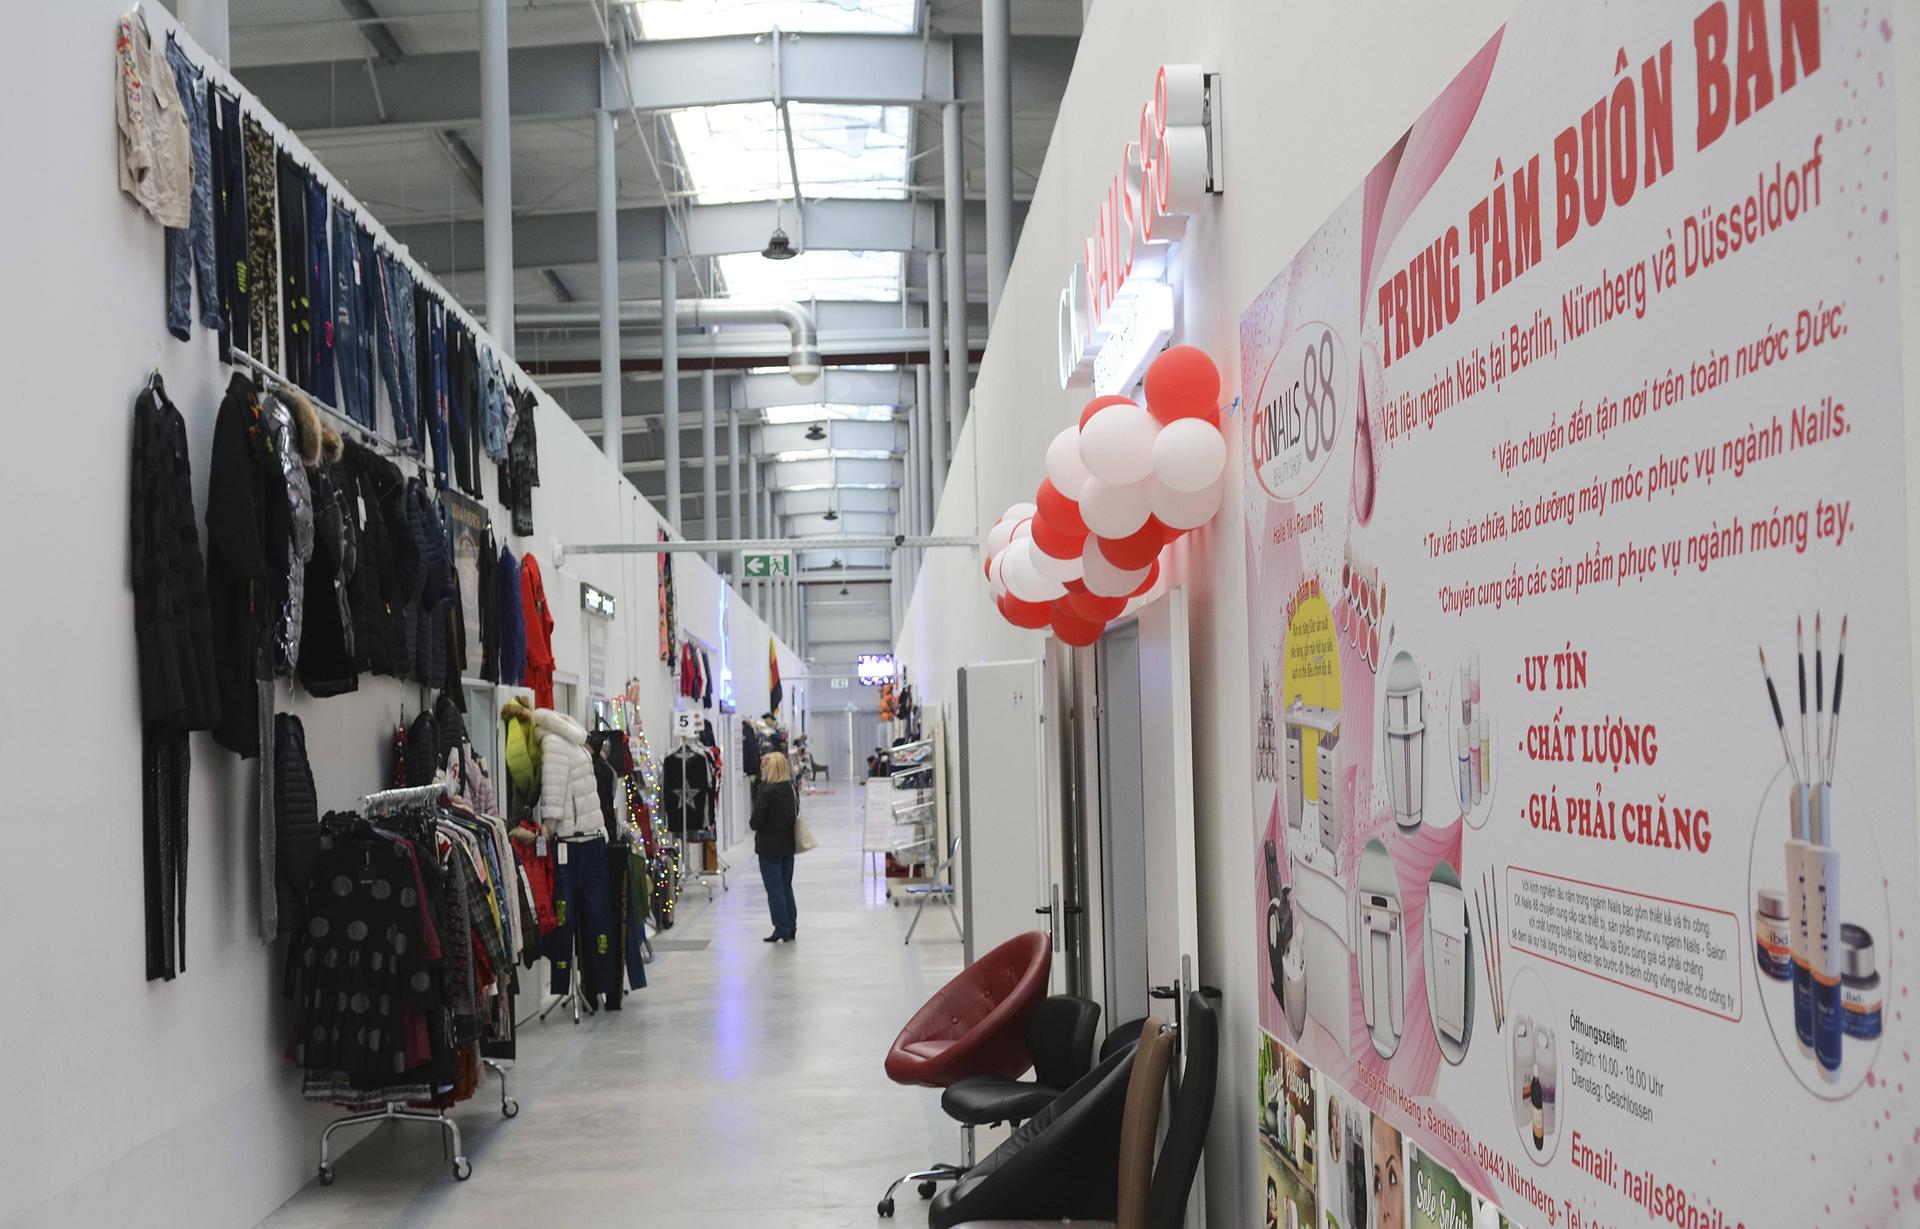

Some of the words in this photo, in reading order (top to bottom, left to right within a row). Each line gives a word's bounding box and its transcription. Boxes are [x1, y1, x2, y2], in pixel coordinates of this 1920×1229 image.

[1379, 226, 1461, 369] TRUNG
[1469, 153, 1542, 305] TÂM
[1554, 40, 1674, 249] BUÔN
[1400, 391, 1418, 440] liệu
[1420, 367, 1454, 430] ngành
[1456, 349, 1487, 402] Nails
[1490, 332, 1506, 392] tại
[1510, 309, 1558, 373] Berlin,
[1562, 260, 1646, 344] Nürnberg
[1652, 228, 1677, 293] và
[1683, 134, 1823, 278] Düsseldorf
[1304, 329, 1336, 462] 88
[1522, 413, 1564, 463] chuyển
[1568, 401, 1592, 444] đến
[1597, 397, 1618, 440] tận
[1622, 379, 1648, 423] nơi
[1652, 368, 1684, 411] trên
[1690, 350, 1730, 396] toàn
[1736, 324, 1789, 378] nước
[1796, 300, 1847, 353] Đức.
[1511, 500, 1531, 533] bảo
[1535, 491, 1574, 526] dưỡng
[1579, 475, 1607, 516] máy
[1611, 464, 1643, 503] móc
[1648, 454, 1689, 502] phục
[1695, 446, 1716, 485] vụ
[1722, 415, 1783, 477] ngành
[1790, 396, 1850, 450] Nails.
[1297, 513, 1312, 535] Raum
[1478, 580, 1501, 609] cung
[1505, 562, 1523, 605] cấp
[1527, 563, 1547, 595] các
[1550, 557, 1572, 590] sản
[1576, 541, 1613, 594] phẩm
[1618, 542, 1657, 587] phục
[1662, 539, 1681, 576] vụ
[1687, 516, 1744, 572] ngành
[1750, 506, 1808, 553] móng
[1816, 499, 1854, 546] tay.
[1525, 655, 1548, 691] UY
[1554, 641, 1587, 690] TÍN
[680, 715, 688, 727] 5
[1526, 706, 1576, 761] CHẤT
[1582, 715, 1658, 773] LƯỢNG
[1529, 784, 1561, 832] GIÁ
[1566, 782, 1616, 840] PHẢI
[1622, 793, 1711, 853] CHĂNG
[1683, 937, 1700, 953] Nails
[1706, 942, 1726, 961] Salon
[1570, 1009, 1628, 1052] Öffnungszeiten:
[1570, 1040, 1597, 1066] Täglich:
[1599, 1053, 1618, 1077] 10.00
[1625, 1065, 1646, 1091] 19.00
[1649, 1074, 1664, 1098] Uhr
[1571, 1068, 1603, 1102] Dienstag:
[1605, 1084, 1653, 1123] Geschlossen
[1427, 1107, 1460, 1149] Sandstr.
[1461, 1130, 1470, 1157] 31
[1478, 1142, 1504, 1183] 90443
[1571, 1130, 1617, 1189] Email:
